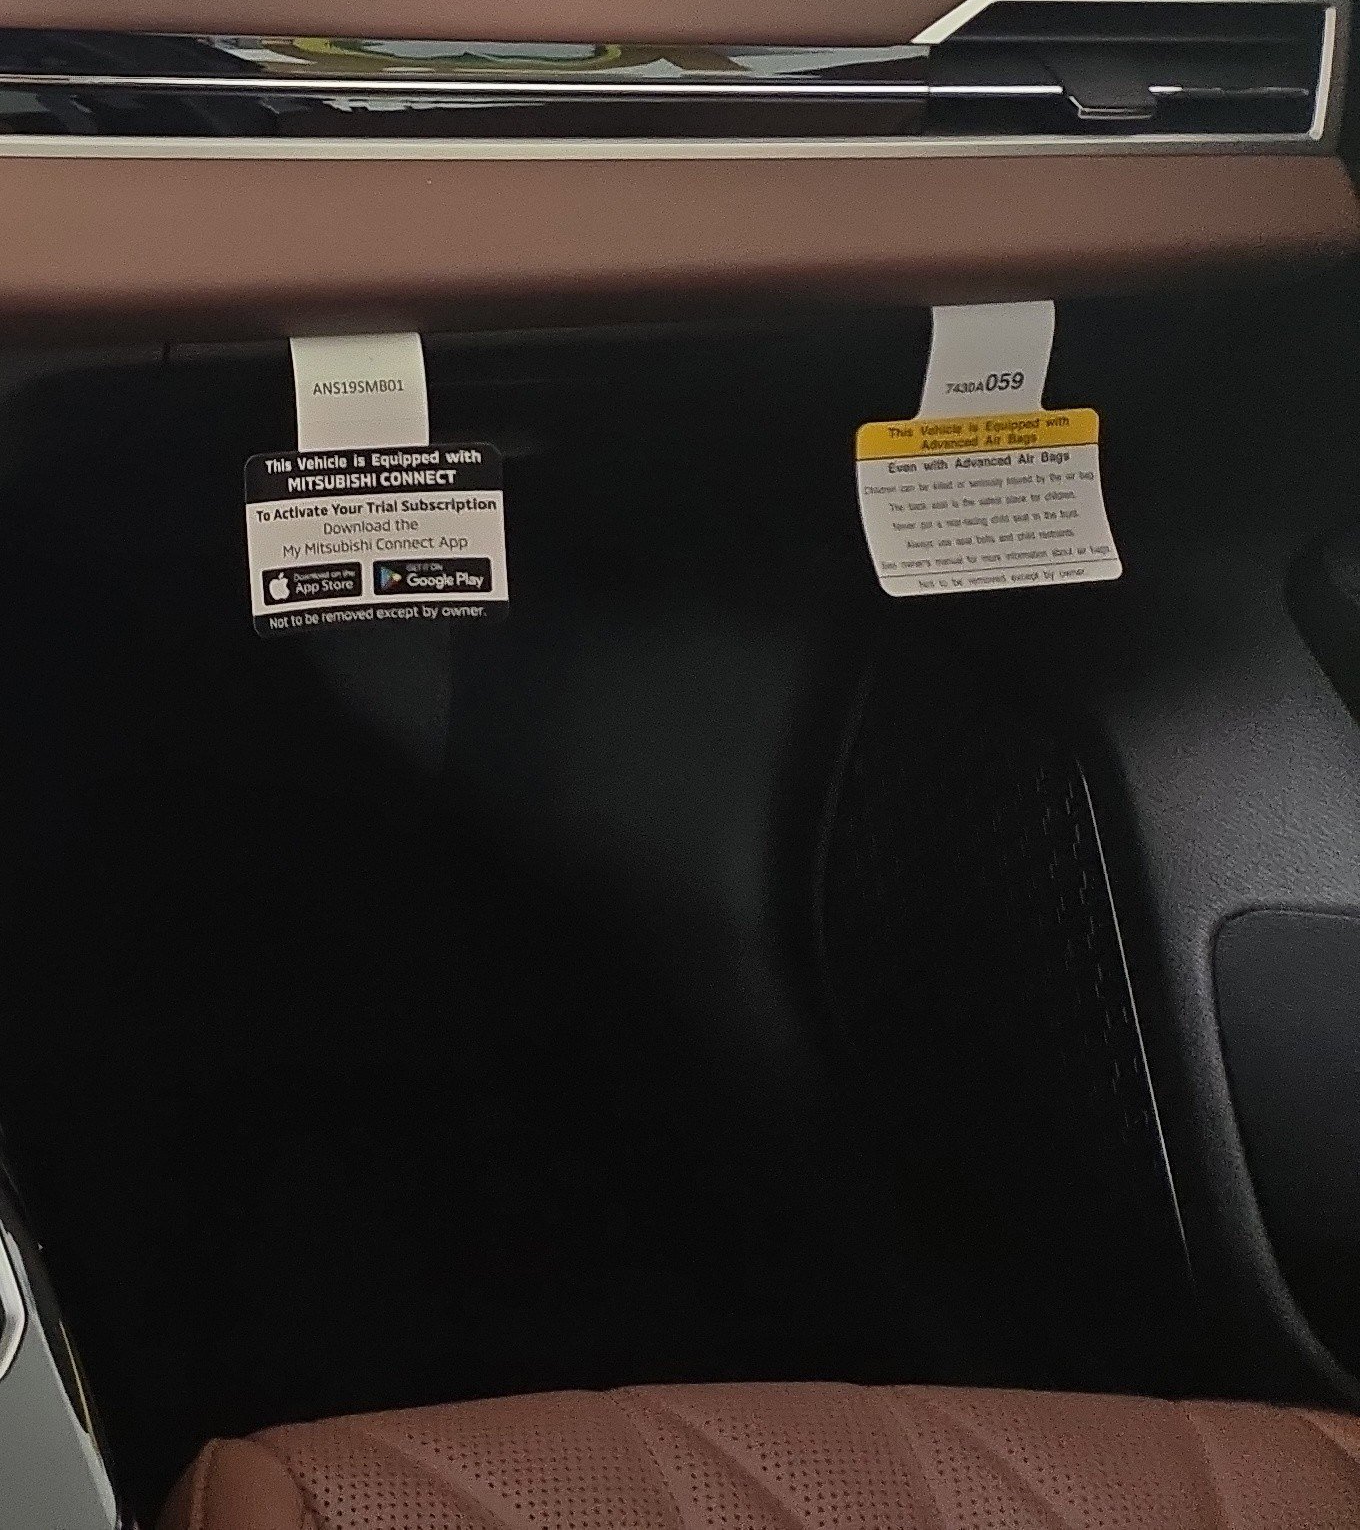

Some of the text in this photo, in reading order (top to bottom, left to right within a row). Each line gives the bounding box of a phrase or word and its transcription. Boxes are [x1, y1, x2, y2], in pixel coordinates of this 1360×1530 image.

[888, 416, 1070, 438] This Vehicle is Equipped with
[922, 433, 1038, 451] Advanced Air Bags
[266, 450, 481, 474] This Vehicle is Equipped with
[888, 451, 1070, 474] Even with Advanced Air Bags
[288, 470, 456, 492] MITSUBISHI CONNECT
[256, 498, 496, 522] To Activate Your Trial Subscription
[324, 520, 418, 534] Download the
[283, 536, 468, 558] My Mitsubishi Connect App
[294, 573, 329, 582] Download
[295, 580, 354, 595] App Store
[407, 571, 484, 589] Google Play
[269, 618, 288, 630] Not
[291, 614, 303, 626] to
[305, 613, 319, 624] be
[322, 609, 373, 623] removed
[377, 608, 418, 620] except
[423, 606, 438, 618] by
